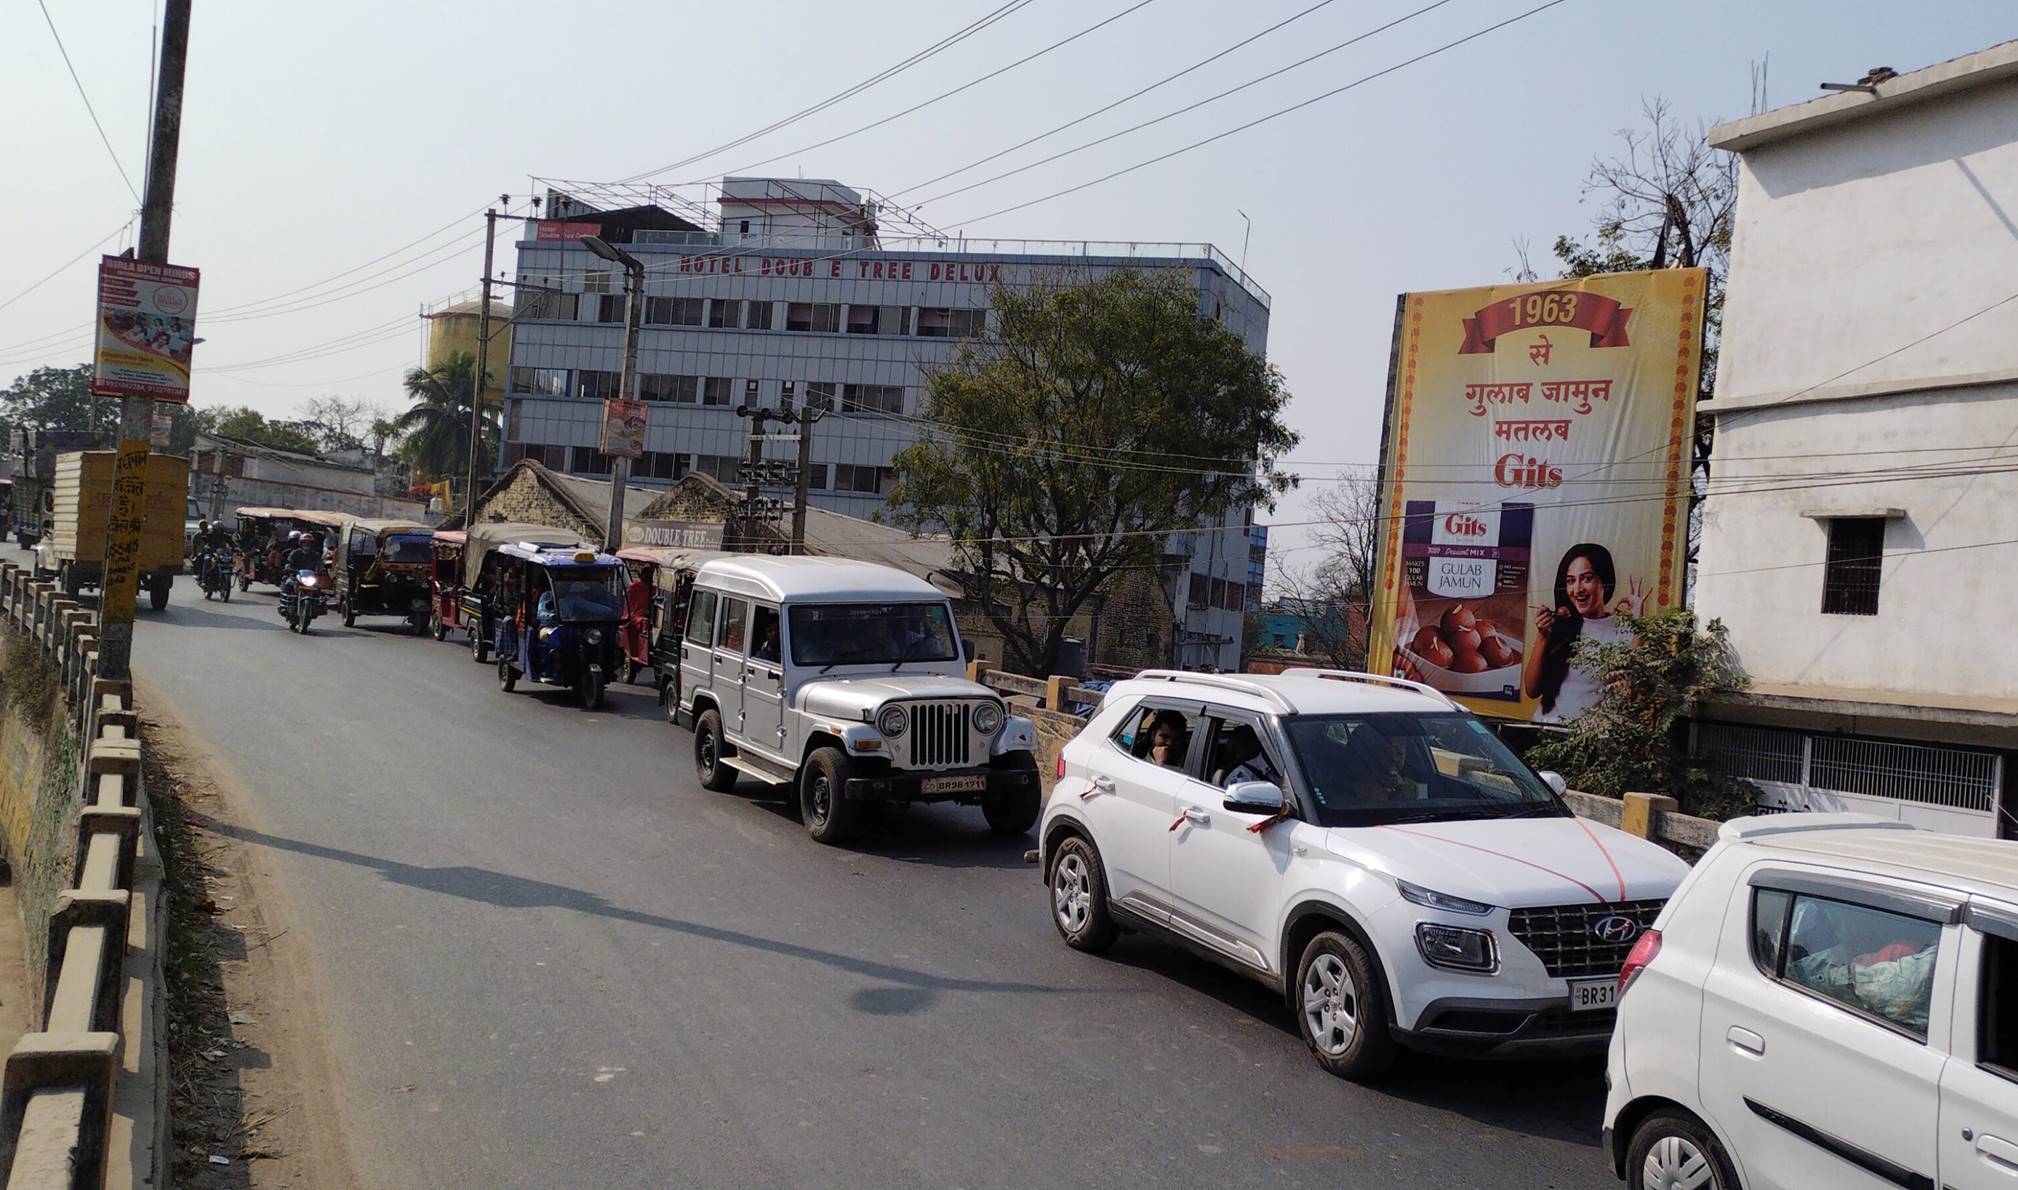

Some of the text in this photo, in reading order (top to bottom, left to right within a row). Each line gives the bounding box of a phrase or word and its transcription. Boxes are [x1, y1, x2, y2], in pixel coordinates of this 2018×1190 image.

[106, 259, 135, 272] BIRLA
[137, 264, 161, 275] OPEN
[679, 255, 742, 273] HOTEL
[860, 260, 912, 280] TREE
[929, 262, 1000, 282] DELUX
[1508, 293, 1578, 326] 1963
[1529, 334, 1553, 367] से
[1465, 379, 1613, 417] गुलाब जामुन
[1495, 419, 1572, 442] मतलब
[1494, 453, 1564, 490] Gits
[1445, 512, 1487, 537] Gits
[644, 527, 681, 546] DOUBLE
[682, 530, 707, 547] TREE
[1441, 562, 1482, 576] GULAB
[1439, 575, 1481, 588] JAMUN
[1582, 985, 1615, 1006] BR31
